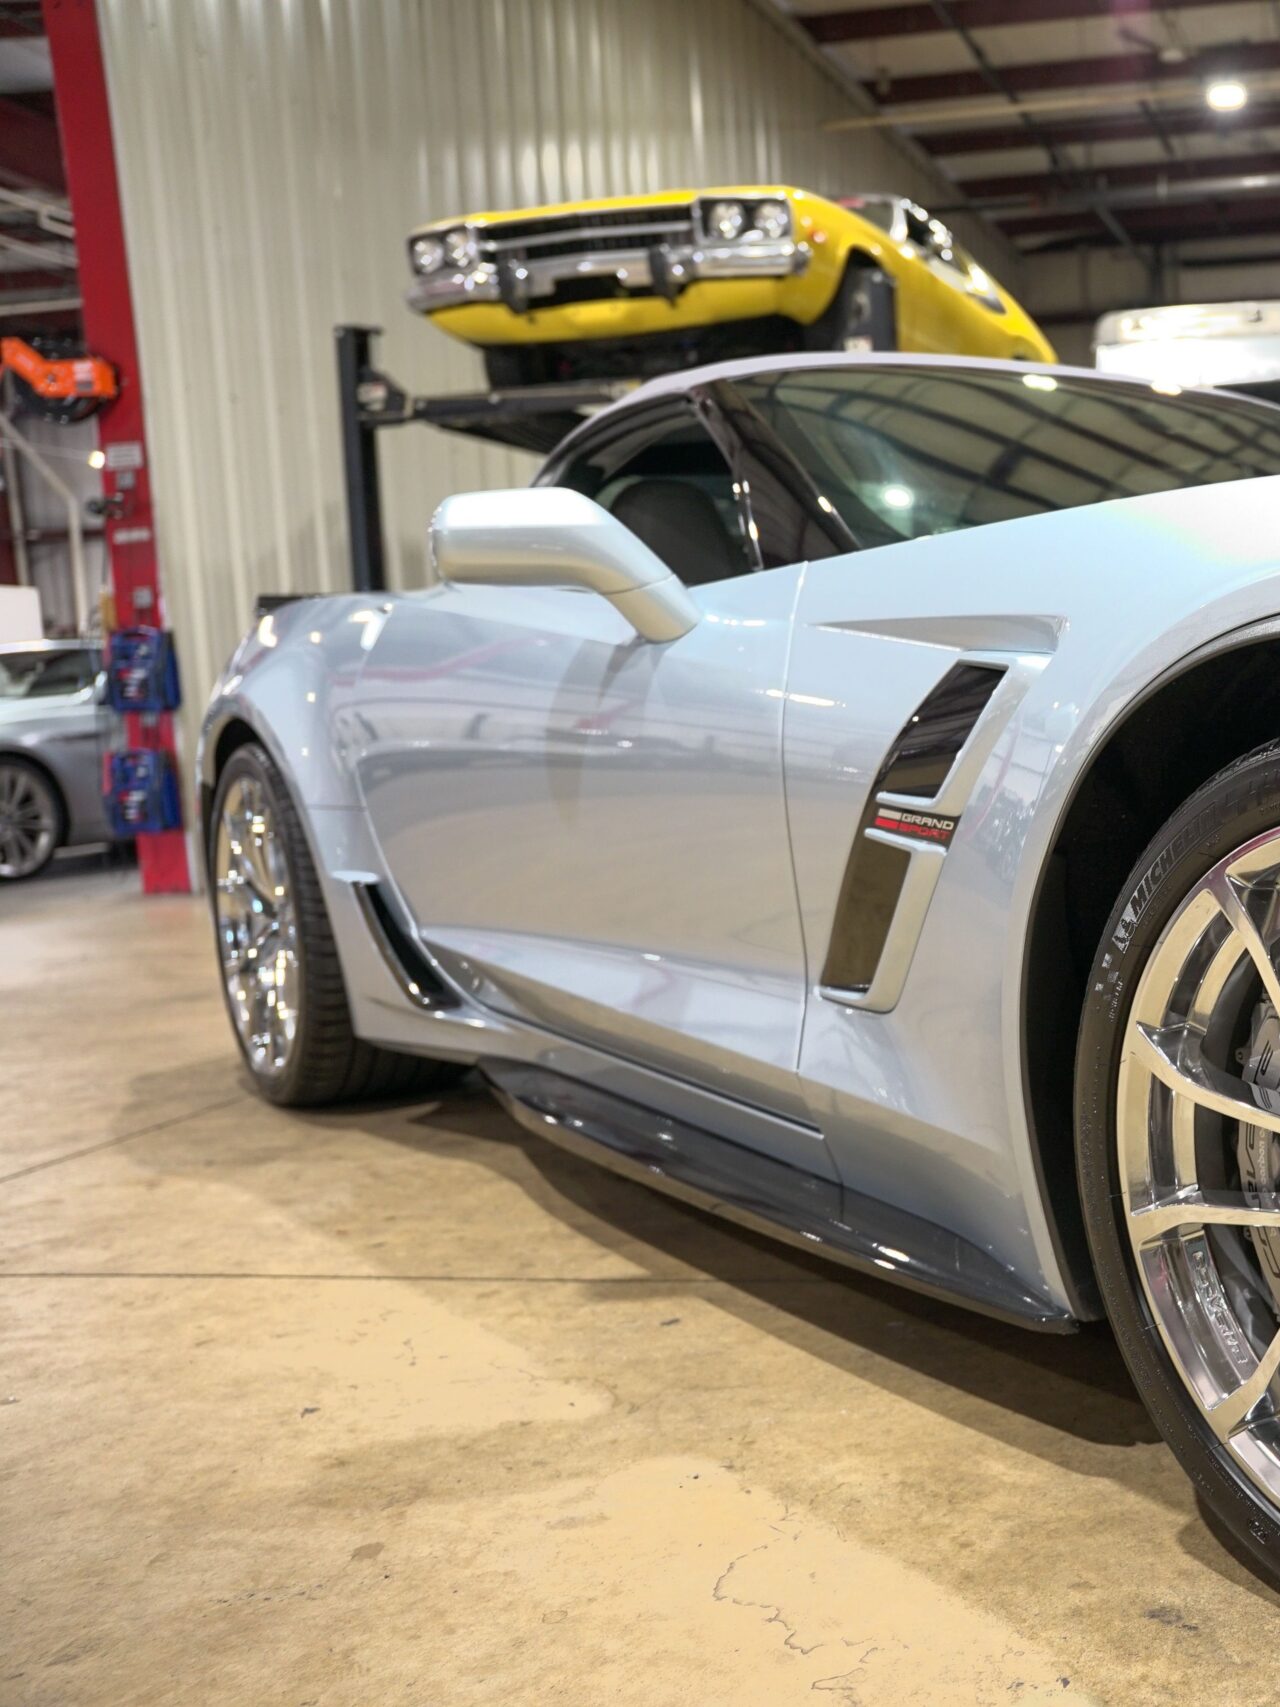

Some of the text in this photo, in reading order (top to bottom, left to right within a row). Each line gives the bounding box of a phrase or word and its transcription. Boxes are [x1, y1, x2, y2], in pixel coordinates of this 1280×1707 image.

[901, 813, 954, 830] GRAND
[898, 822, 950, 840] SPORT
[1129, 804, 1225, 919] MICHELIN
